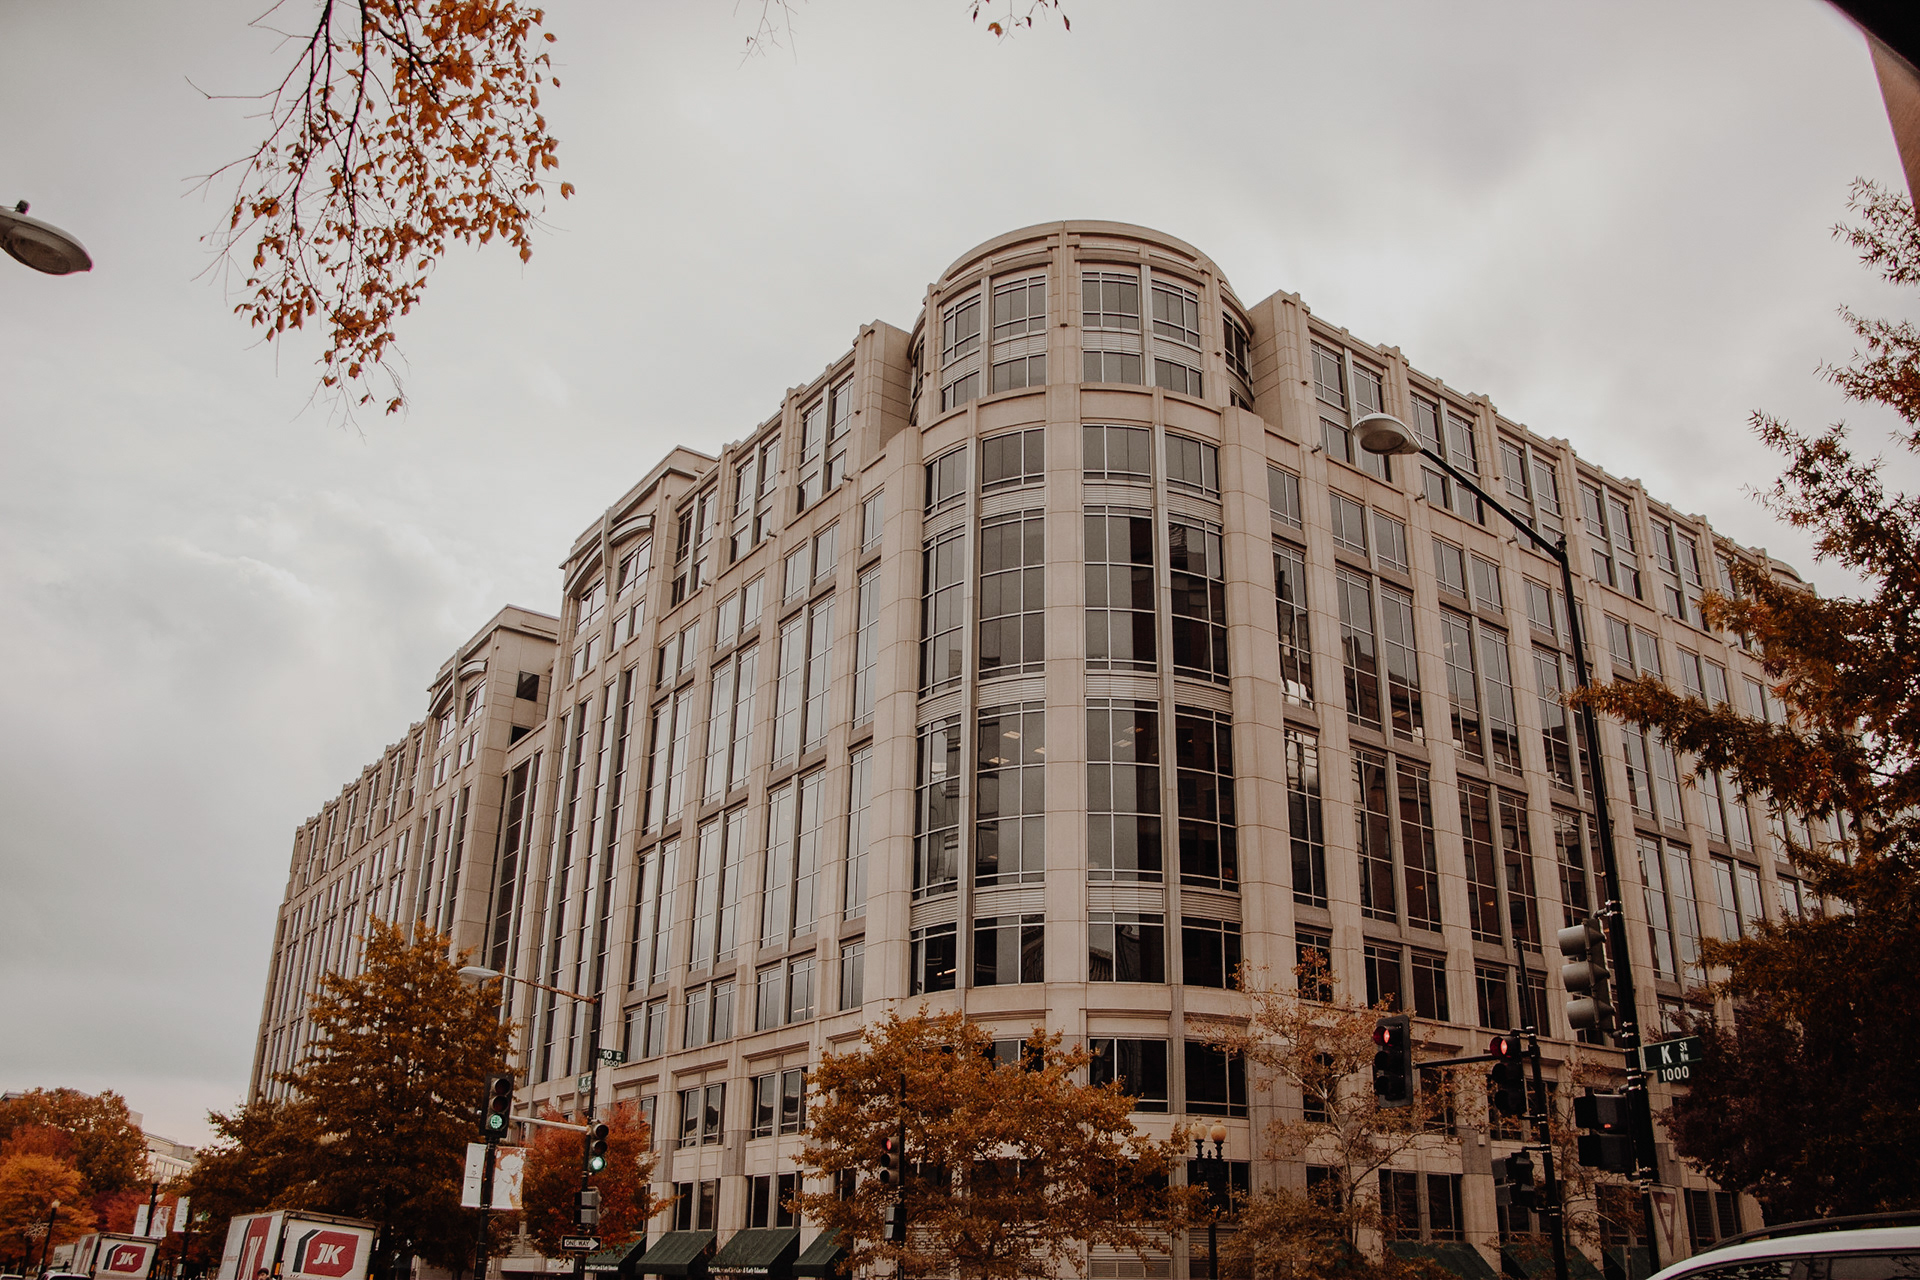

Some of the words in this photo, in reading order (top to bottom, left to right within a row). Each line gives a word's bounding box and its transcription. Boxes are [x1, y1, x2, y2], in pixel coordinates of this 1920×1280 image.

[1661, 1045, 1672, 1064] K
[1679, 1042, 1688, 1052] St
[1662, 1066, 1689, 1082] 1000
[116, 1252, 138, 1265] JK
[312, 1243, 346, 1265] JK
